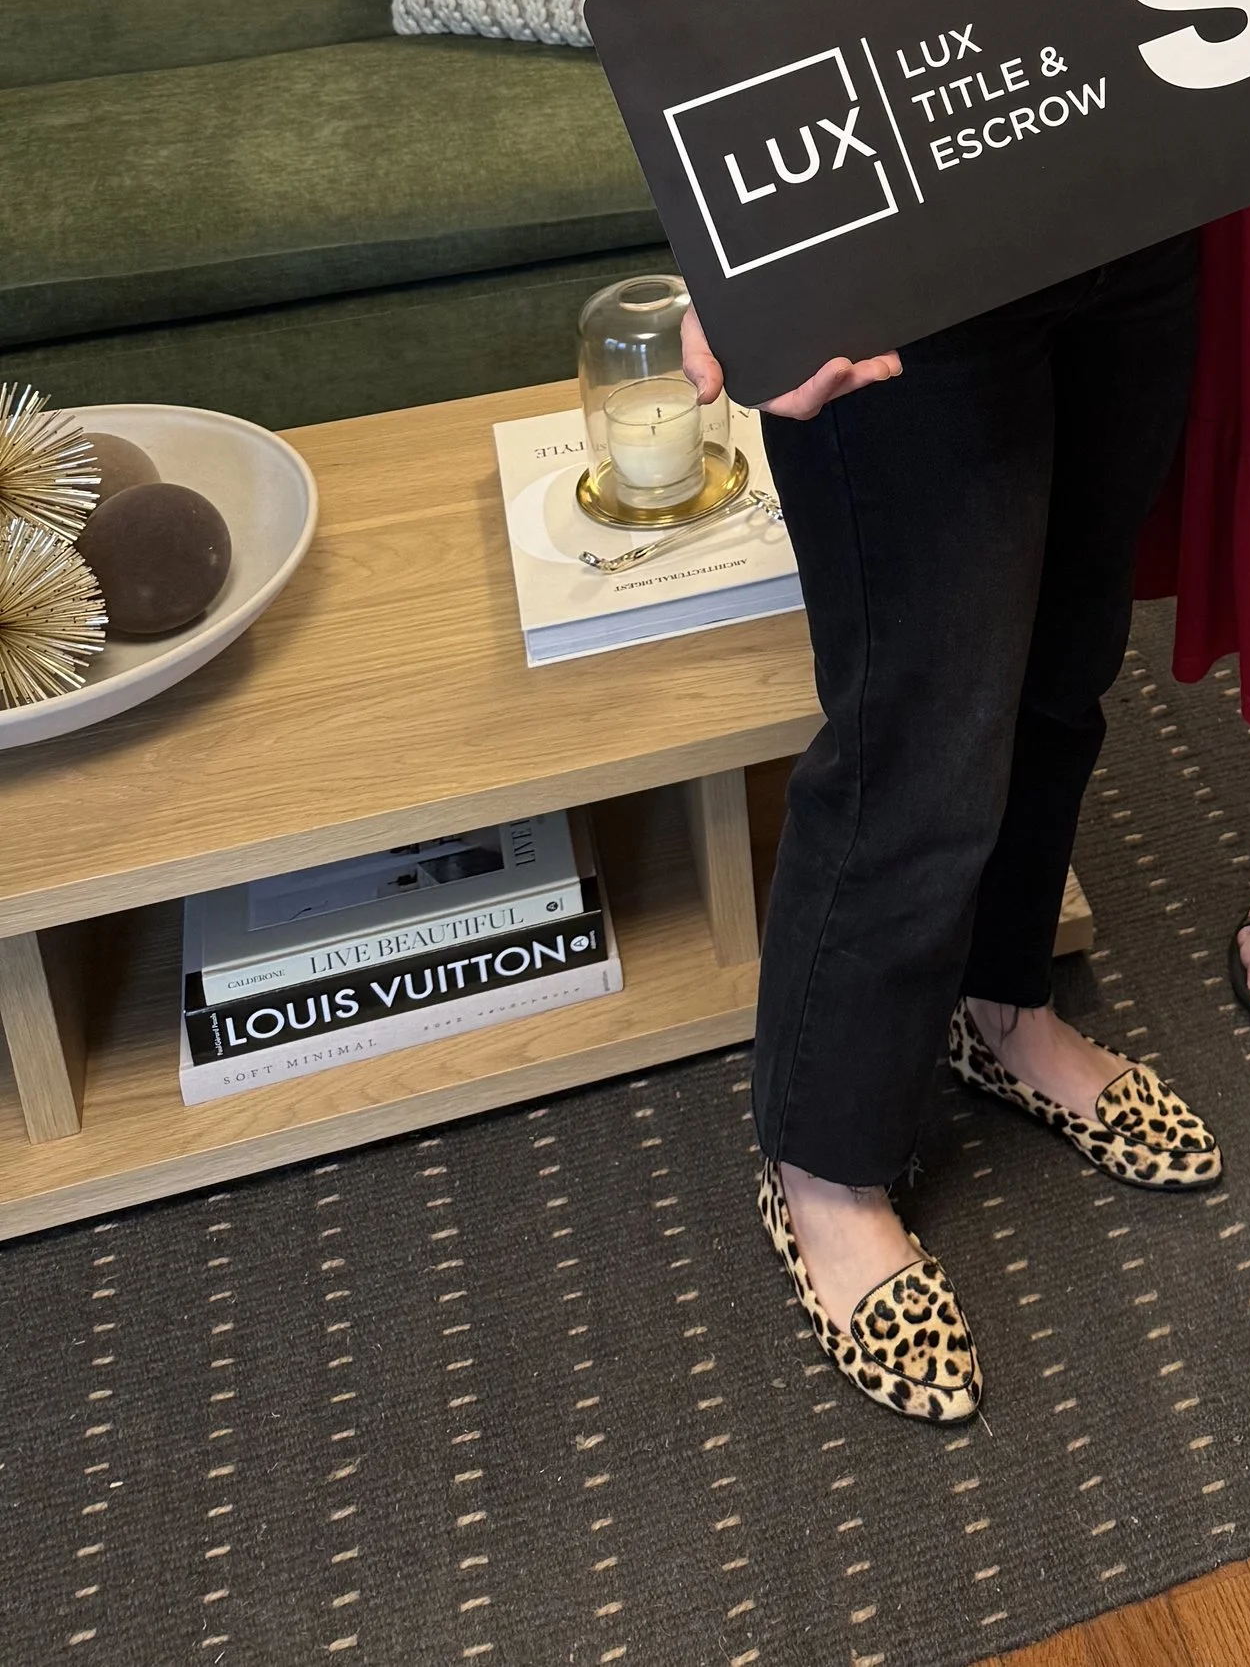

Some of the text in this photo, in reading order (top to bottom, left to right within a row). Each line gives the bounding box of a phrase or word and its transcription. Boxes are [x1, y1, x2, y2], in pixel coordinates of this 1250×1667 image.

[896, 23, 983, 79] LUX
[911, 46, 1069, 123] TITLE &
[723, 106, 878, 205] LUX
[929, 76, 1107, 171] ESCROW
[613, 558, 748, 593] ARCHITECTURAL DIGEST
[310, 942, 371, 975] LIVE
[377, 907, 525, 958] BEAUTIFUL
[225, 987, 360, 1047] LOUIS
[370, 934, 566, 1008] VUITTON
[223, 1038, 377, 1085] SOFT MINIMAL
